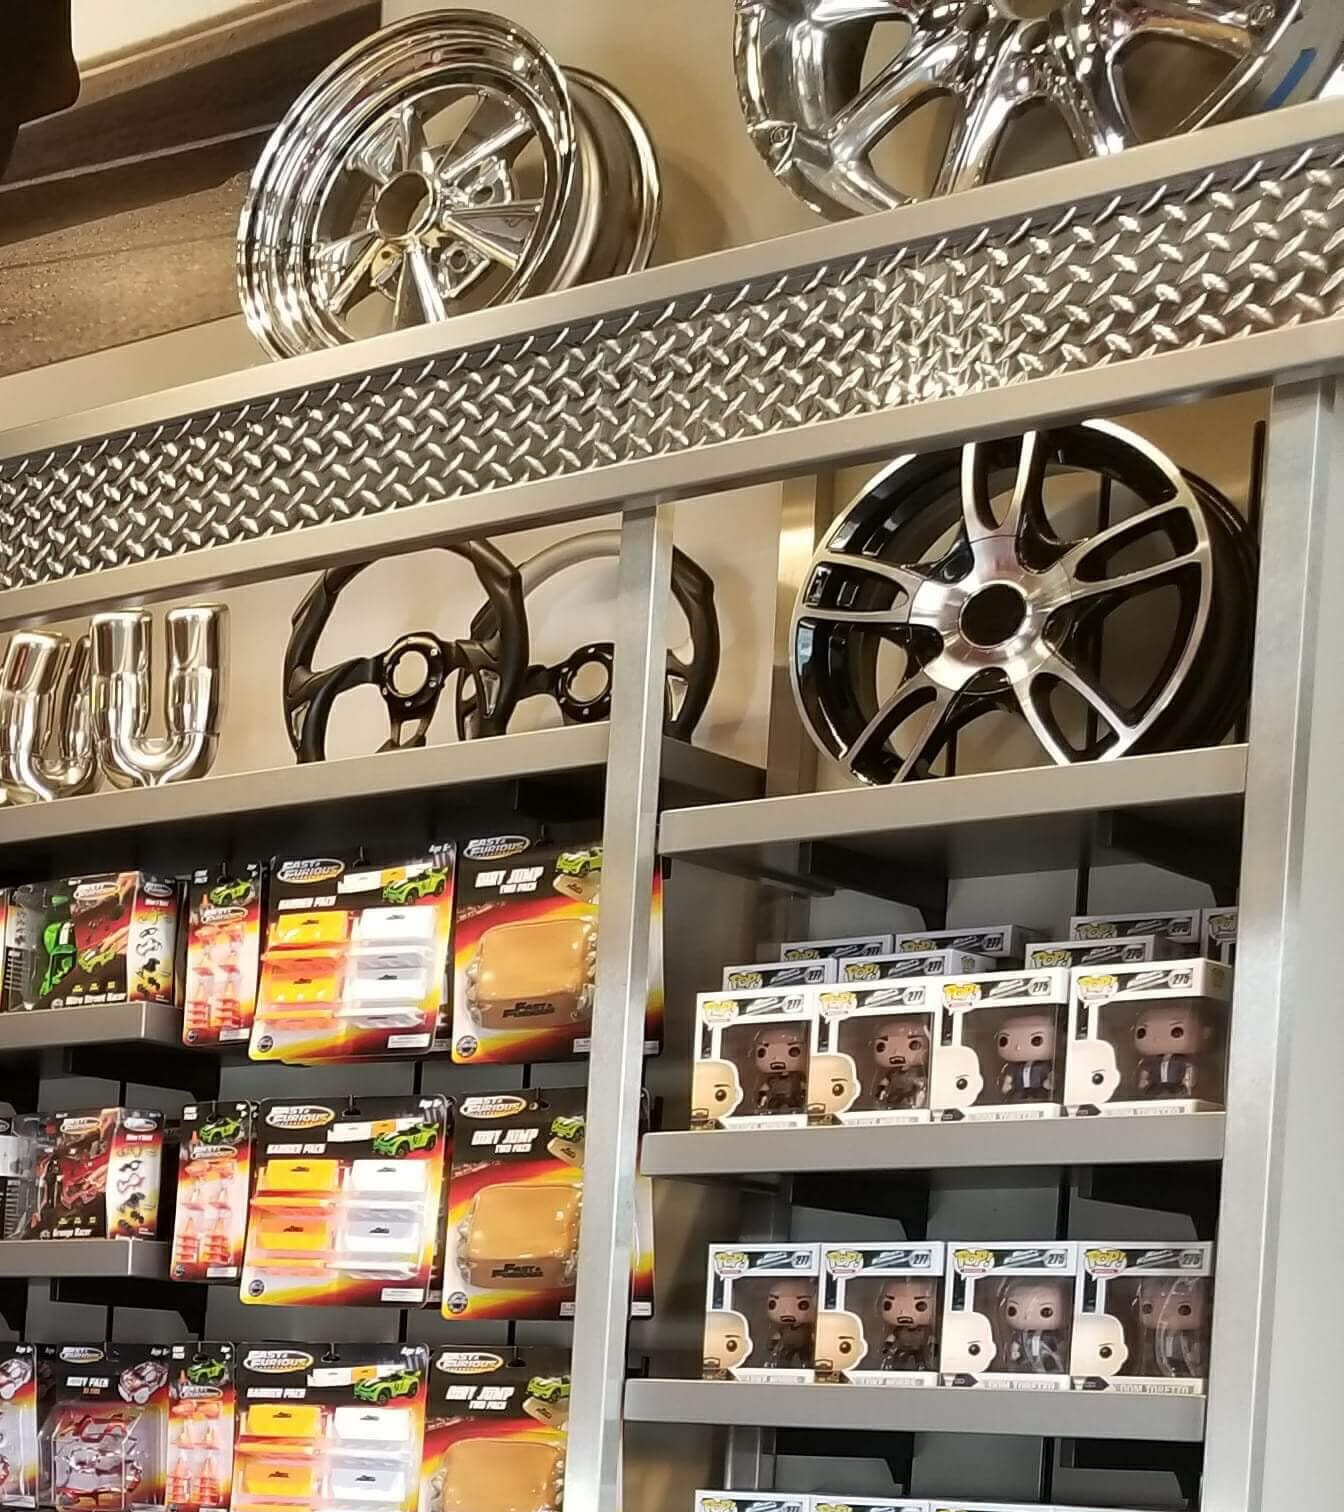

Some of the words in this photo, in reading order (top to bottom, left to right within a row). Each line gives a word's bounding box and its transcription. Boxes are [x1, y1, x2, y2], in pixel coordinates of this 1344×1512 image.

[1032, 981, 1048, 992] 275
[796, 1255, 809, 1265] 277
[913, 1254, 929, 1265] 277
